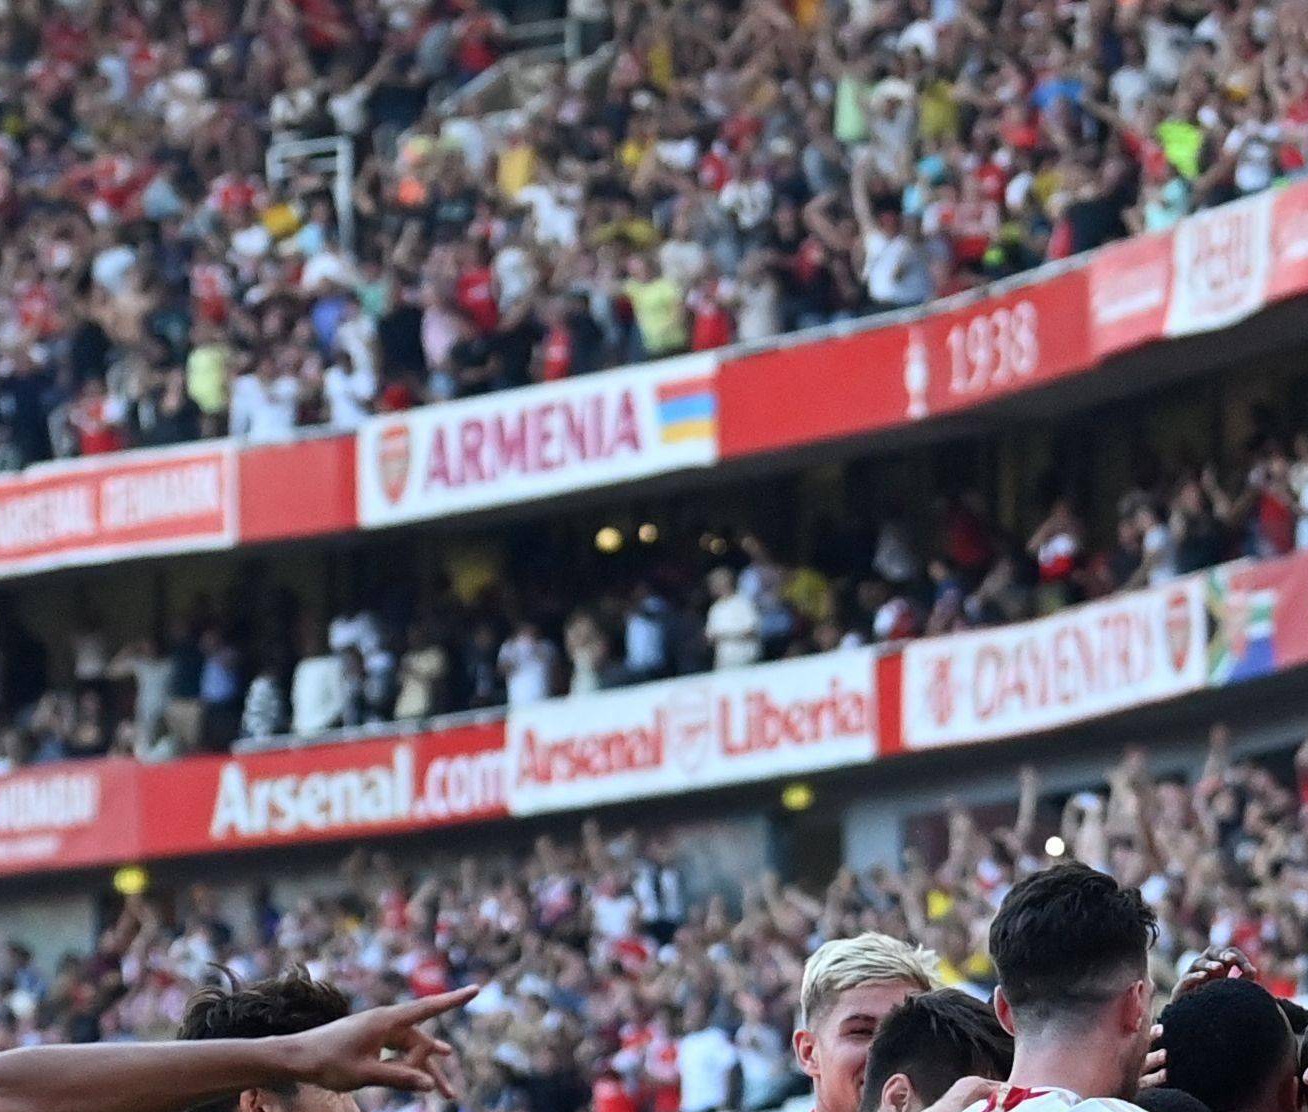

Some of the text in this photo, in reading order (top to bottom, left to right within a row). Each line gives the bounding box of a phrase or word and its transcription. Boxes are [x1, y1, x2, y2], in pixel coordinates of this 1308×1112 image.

[945, 302, 1039, 395] 1938
[423, 389, 642, 492] ARMENIA
[974, 612, 1156, 722] DAVENTRY
[516, 682, 870, 785] Arsenal Liberia
[210, 744, 508, 842] Arsenal.com
